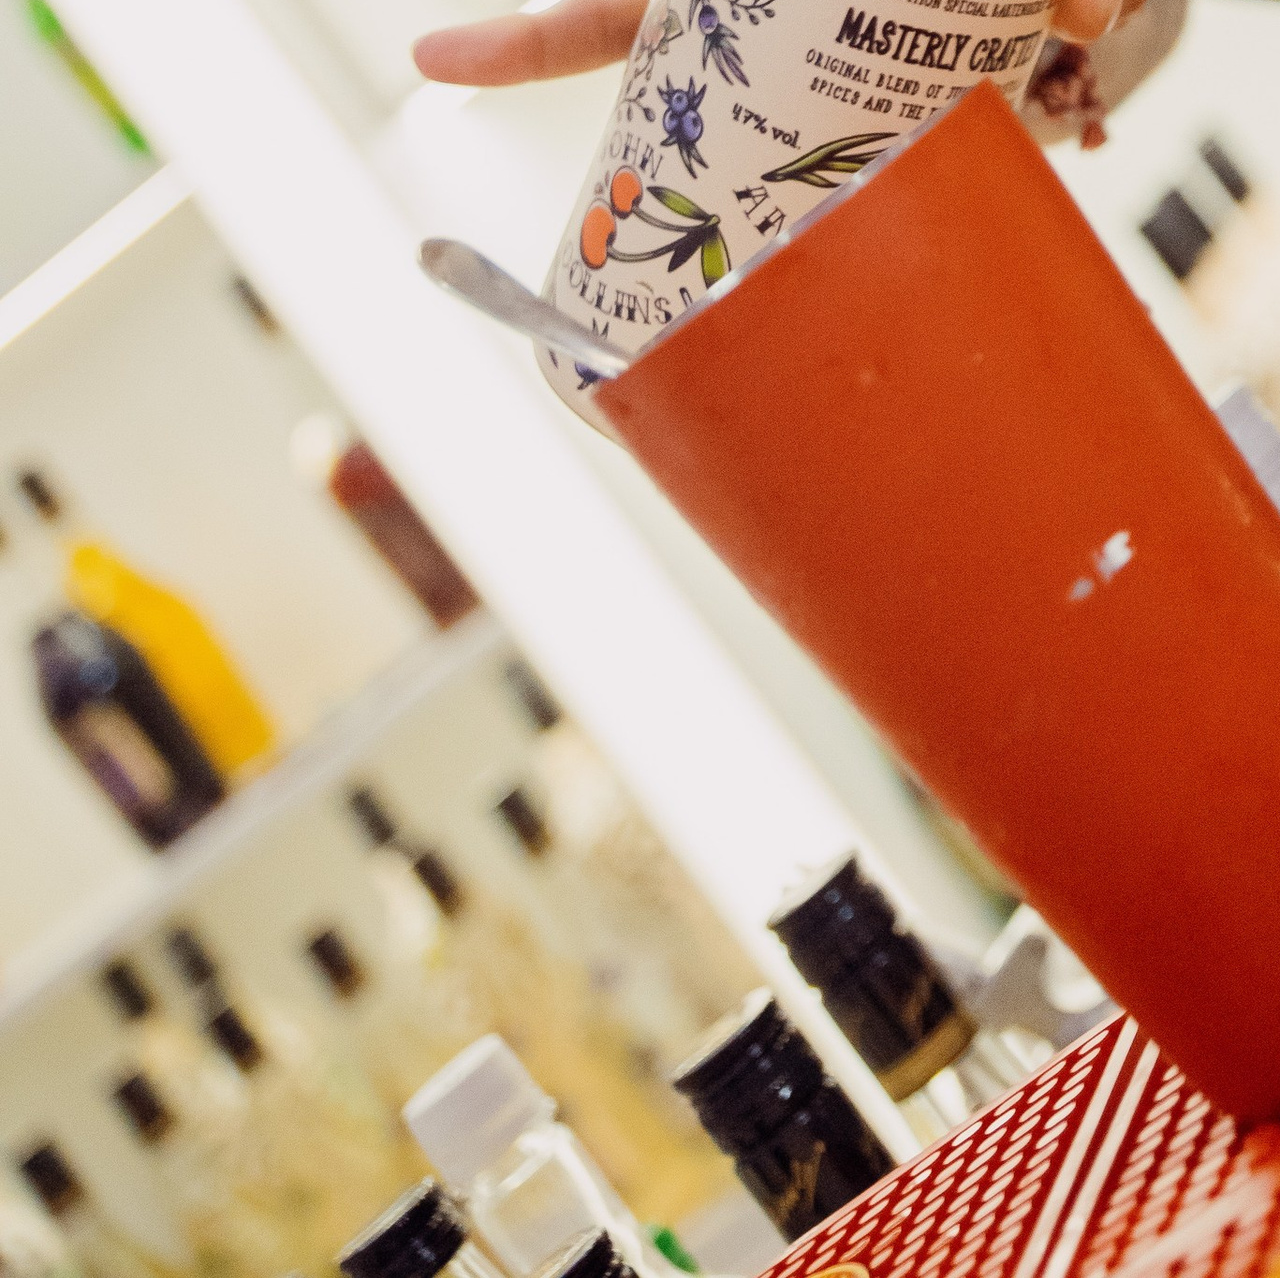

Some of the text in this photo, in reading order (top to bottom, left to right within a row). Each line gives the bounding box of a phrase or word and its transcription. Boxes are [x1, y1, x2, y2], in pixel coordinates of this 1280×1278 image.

[835, 6, 972, 72] MASTERLY
[806, 48, 869, 84] ORIGINAL
[875, 72, 920, 96] BLEND
[925, 84, 945, 99] OF
[732, 102, 769, 135] 47%
[811, 76, 858, 106] SPICES
[862, 94, 893, 114] AND
[898, 104, 926, 121] THE
